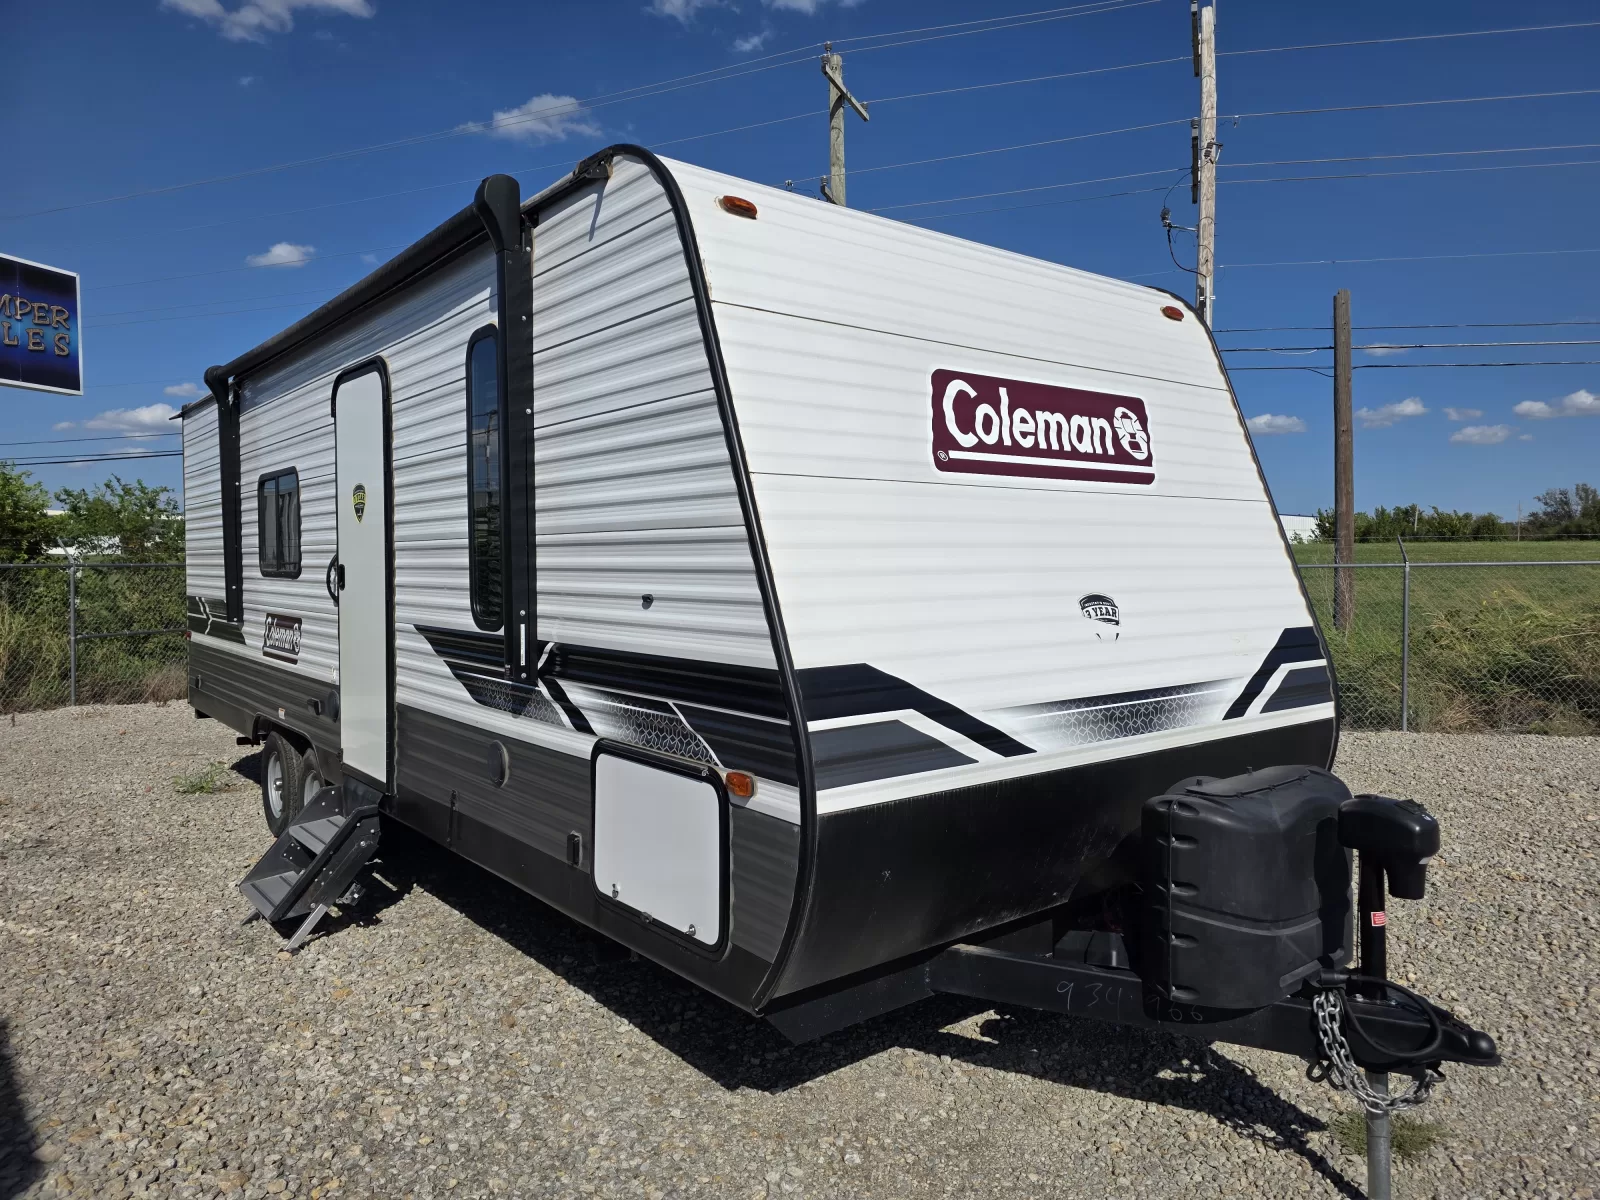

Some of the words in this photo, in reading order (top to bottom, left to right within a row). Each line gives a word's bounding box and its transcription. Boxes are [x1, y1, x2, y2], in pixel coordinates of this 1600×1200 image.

[942, 379, 1116, 456] Coleman
[1092, 606, 1117, 618] YEAR
[265, 616, 294, 650] Coleman
